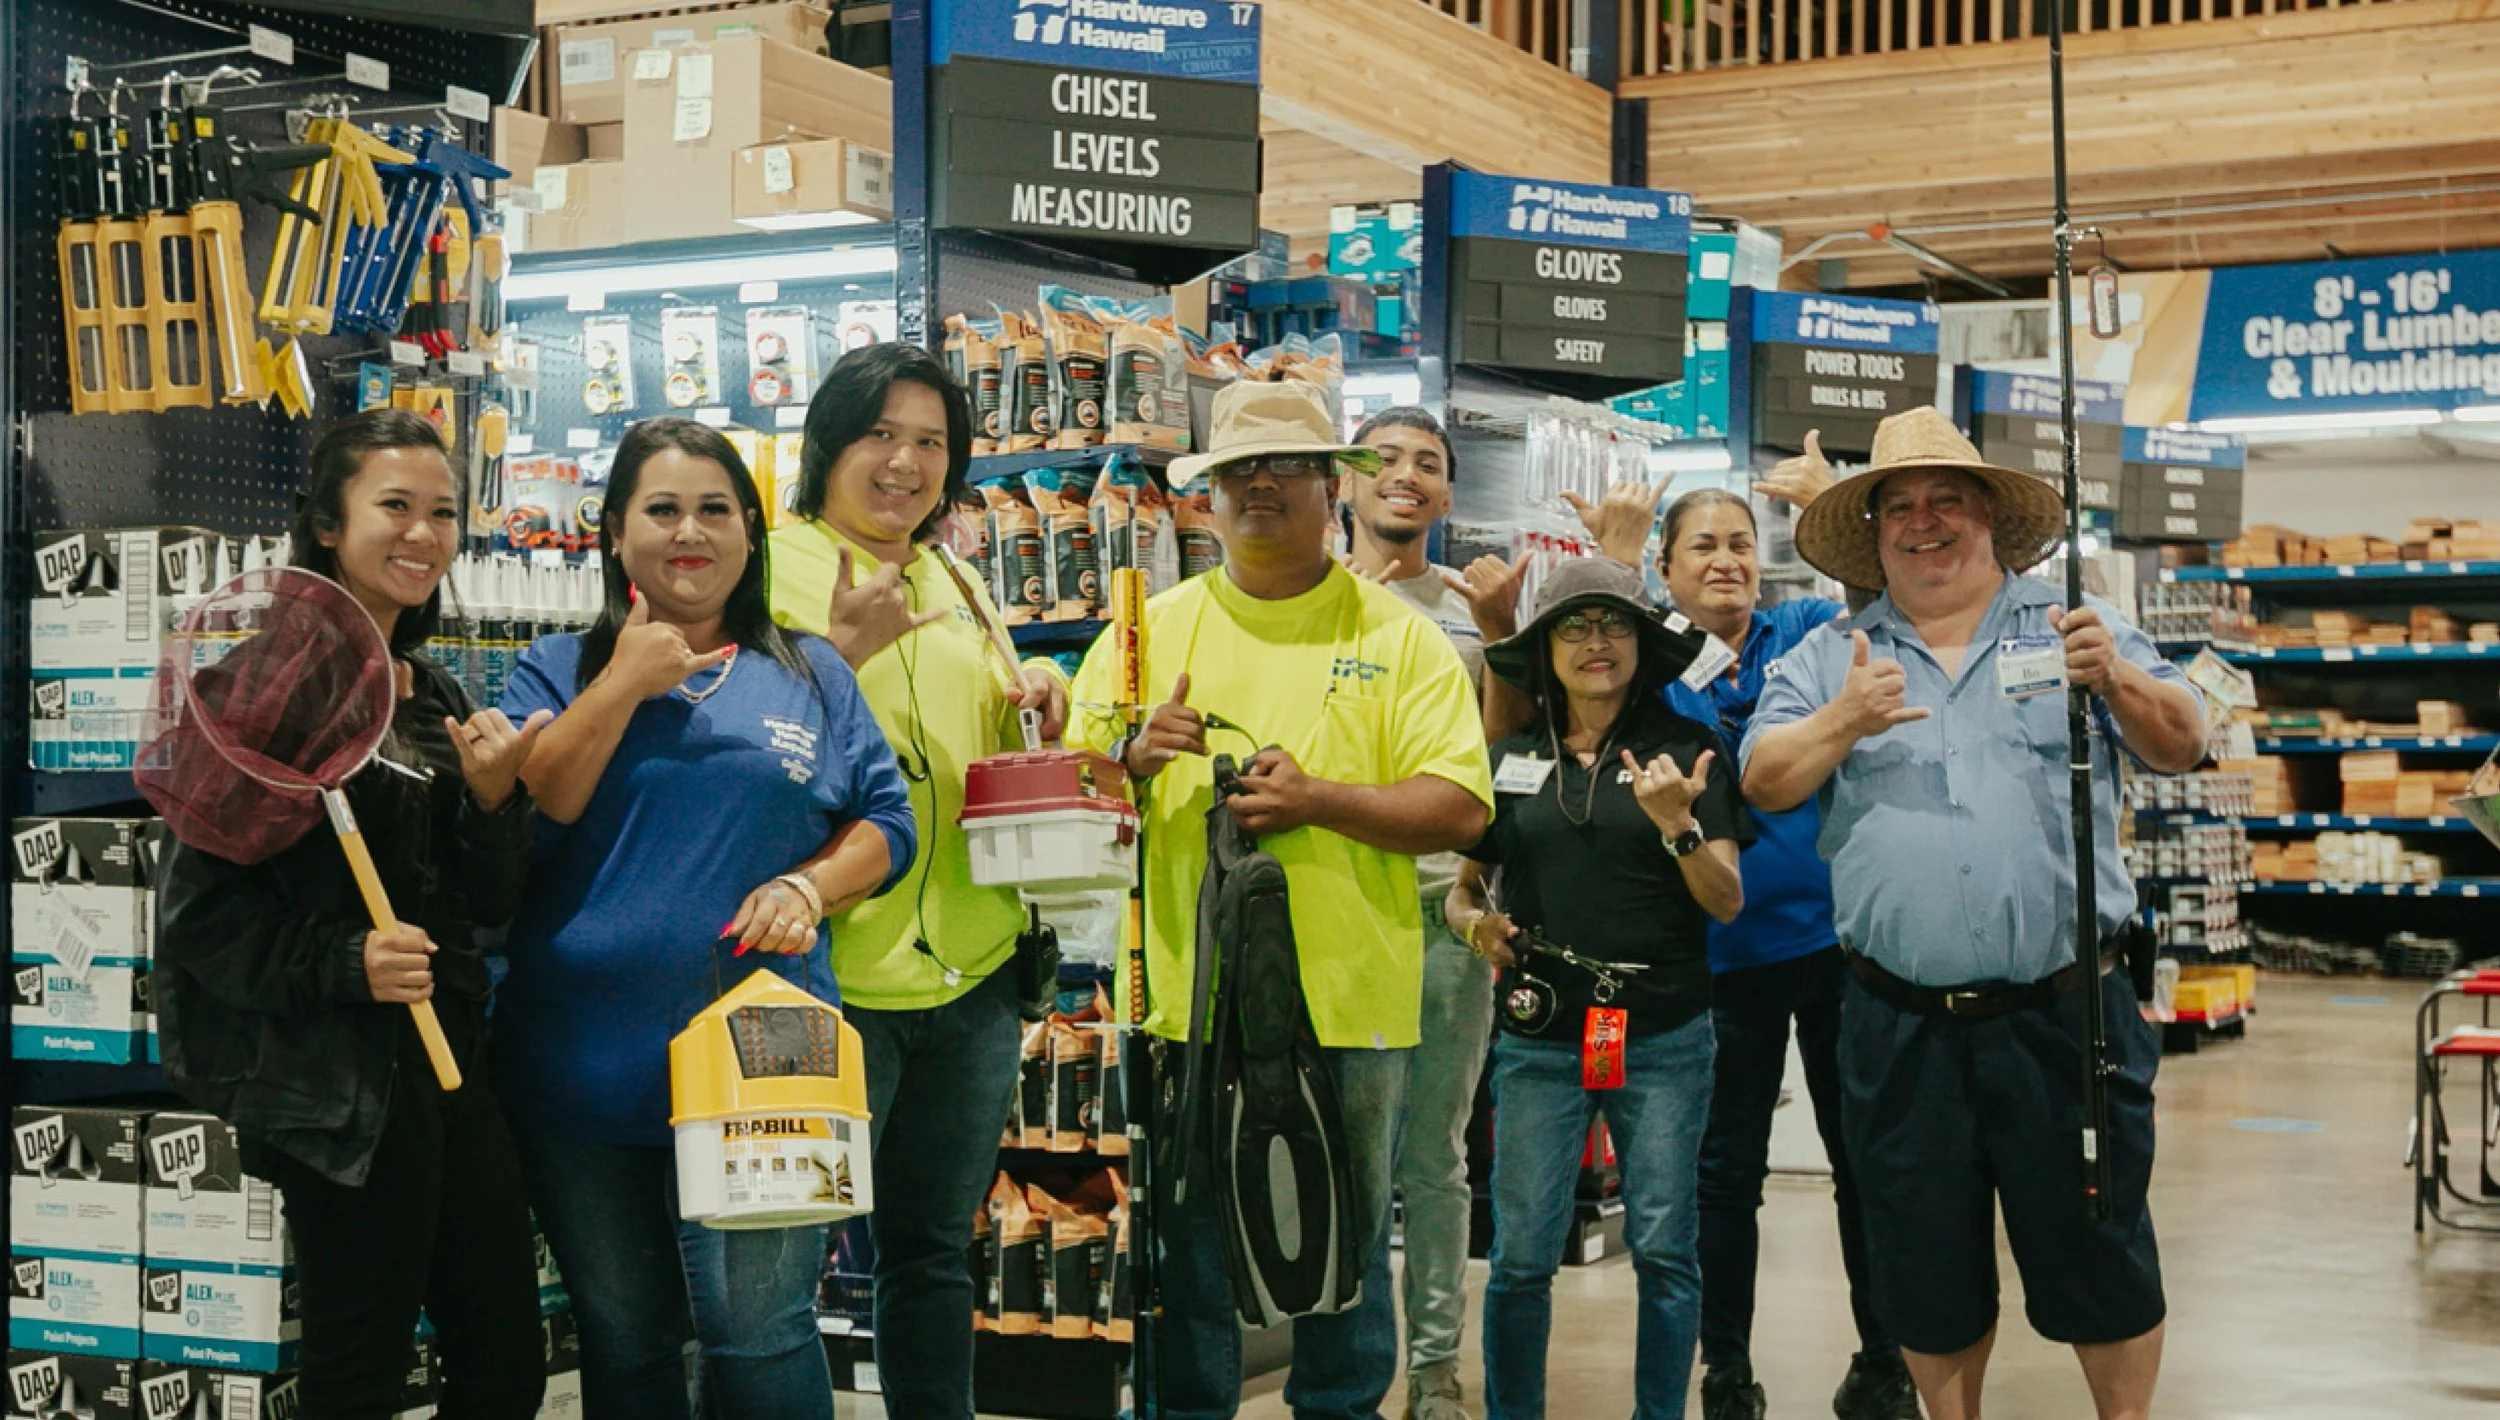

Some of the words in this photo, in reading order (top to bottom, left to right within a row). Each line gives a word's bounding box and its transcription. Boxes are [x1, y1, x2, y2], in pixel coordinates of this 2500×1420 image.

[1072, 0, 1208, 28] Hardware
[1229, 4, 1254, 26] 17
[1070, 22, 1165, 53] Hawaii
[1051, 73, 1157, 121] CHISEL
[1052, 130, 1160, 177] LEVELS
[1011, 183, 1192, 236] MEASURING
[1552, 190, 1659, 219] Hardware
[1667, 195, 1691, 216] 18
[1552, 213, 1627, 239] Hawaii
[1535, 247, 1623, 284] GLOVES
[1553, 295, 1607, 321] GLOVES
[2313, 274, 2355, 319] 8'
[2358, 289, 2381, 305] -
[2386, 267, 2451, 314] 16'
[1554, 338, 1605, 363] SAFETY
[2243, 316, 2354, 359] Clear
[1805, 349, 1857, 377] POWER
[1858, 353, 1905, 381] TOOLS
[2266, 357, 2302, 400] &
[43, 541, 83, 583] DAP
[22, 829, 57, 868] DAP
[23, 1123, 61, 1161] DAP
[159, 1133, 200, 1173] DAP
[19, 1264, 39, 1284] DAP
[48, 1270, 73, 1287] ALEX
[154, 1277, 175, 1298] DAP
[186, 1283, 213, 1300] ALEX
[18, 1366, 57, 1404] DAP
[149, 1378, 187, 1418] DAP
